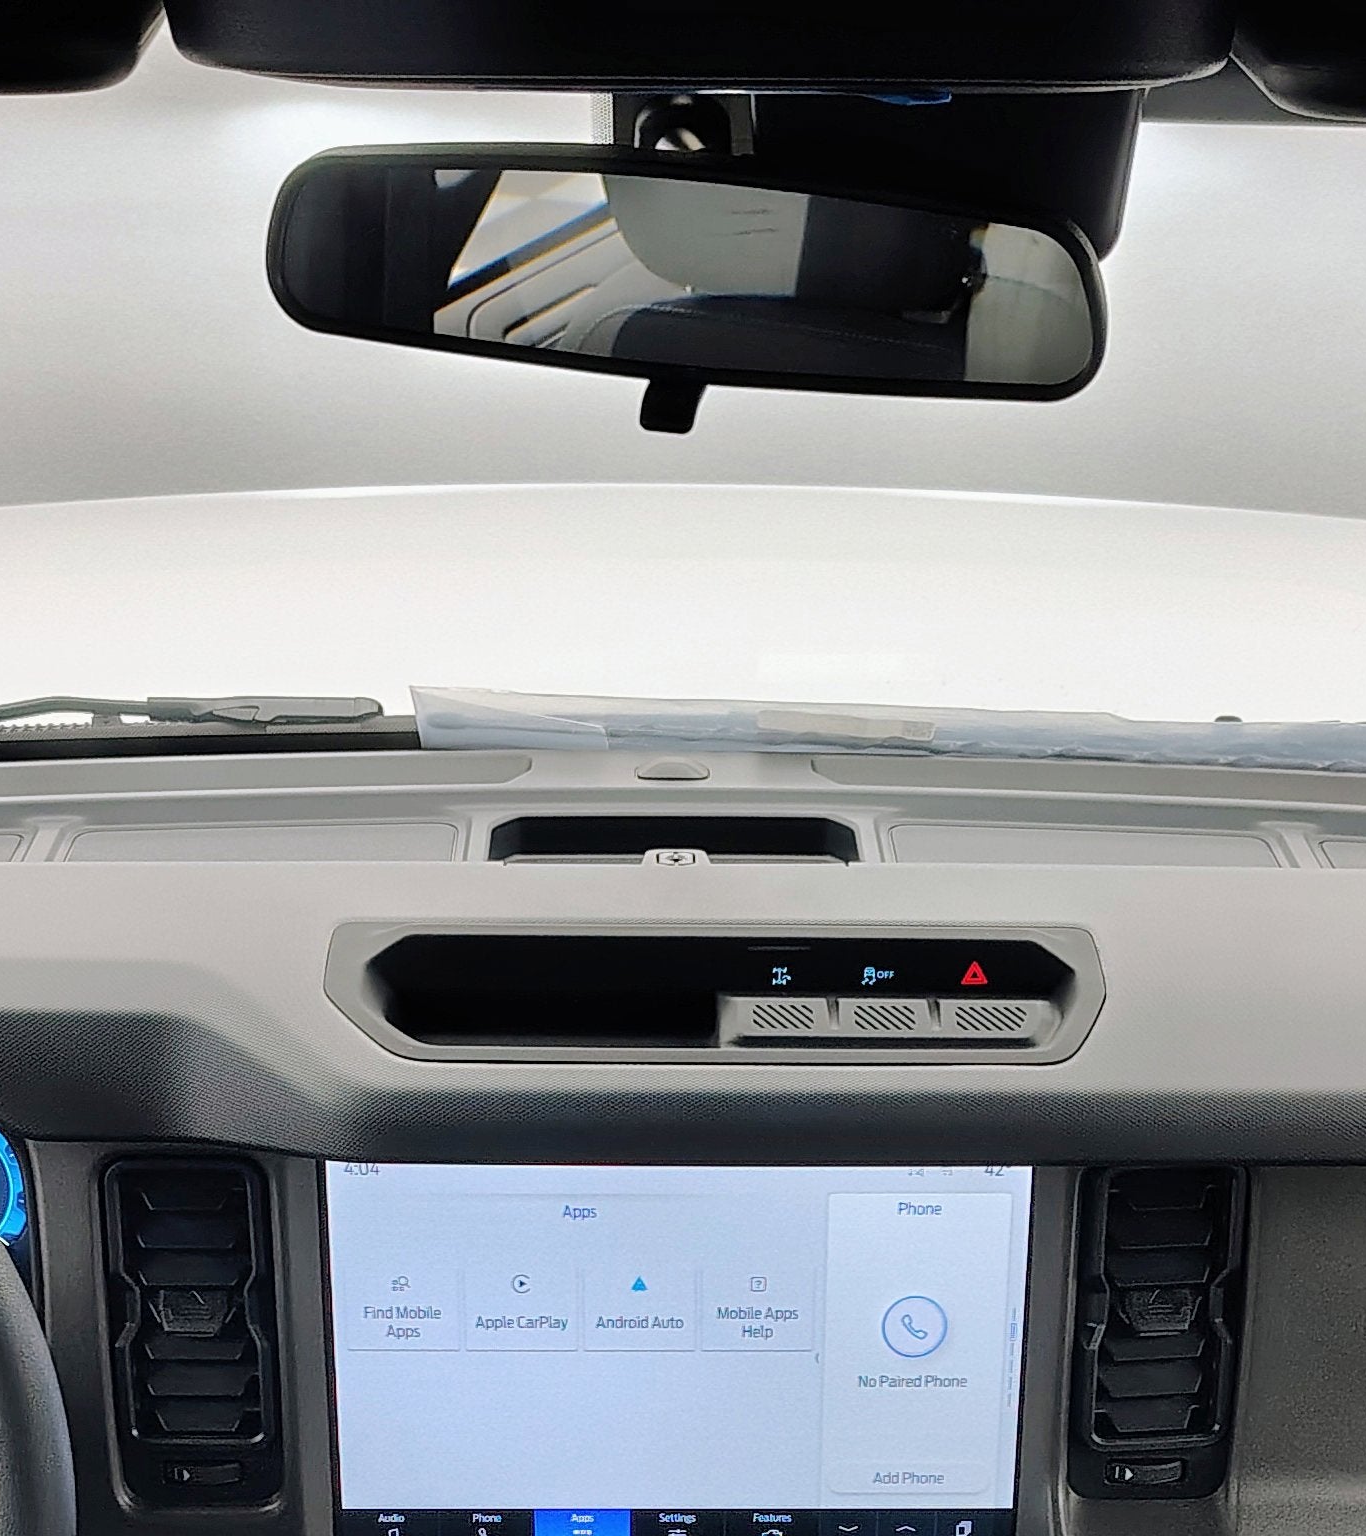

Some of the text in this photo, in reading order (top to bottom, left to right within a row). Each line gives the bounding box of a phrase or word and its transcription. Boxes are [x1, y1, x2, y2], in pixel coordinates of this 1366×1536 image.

[876, 970, 895, 980] OFF
[563, 1205, 598, 1220] Apps
[897, 1201, 942, 1216] Phone
[363, 1306, 442, 1320] Find Mobile
[716, 1306, 799, 1322] Mobile Apps
[475, 1315, 568, 1331] Apple CarPlay
[595, 1315, 685, 1329] Android Auto
[386, 1324, 421, 1340] Apps
[741, 1325, 774, 1340] Help
[858, 1374, 968, 1388] No Paired Phone
[872, 1471, 945, 1485] Add Phone
[377, 1513, 405, 1523] Audio
[472, 1513, 502, 1523] Phone
[570, 1513, 595, 1524] Apps
[658, 1512, 697, 1525] Settings
[752, 1512, 793, 1523] Features
